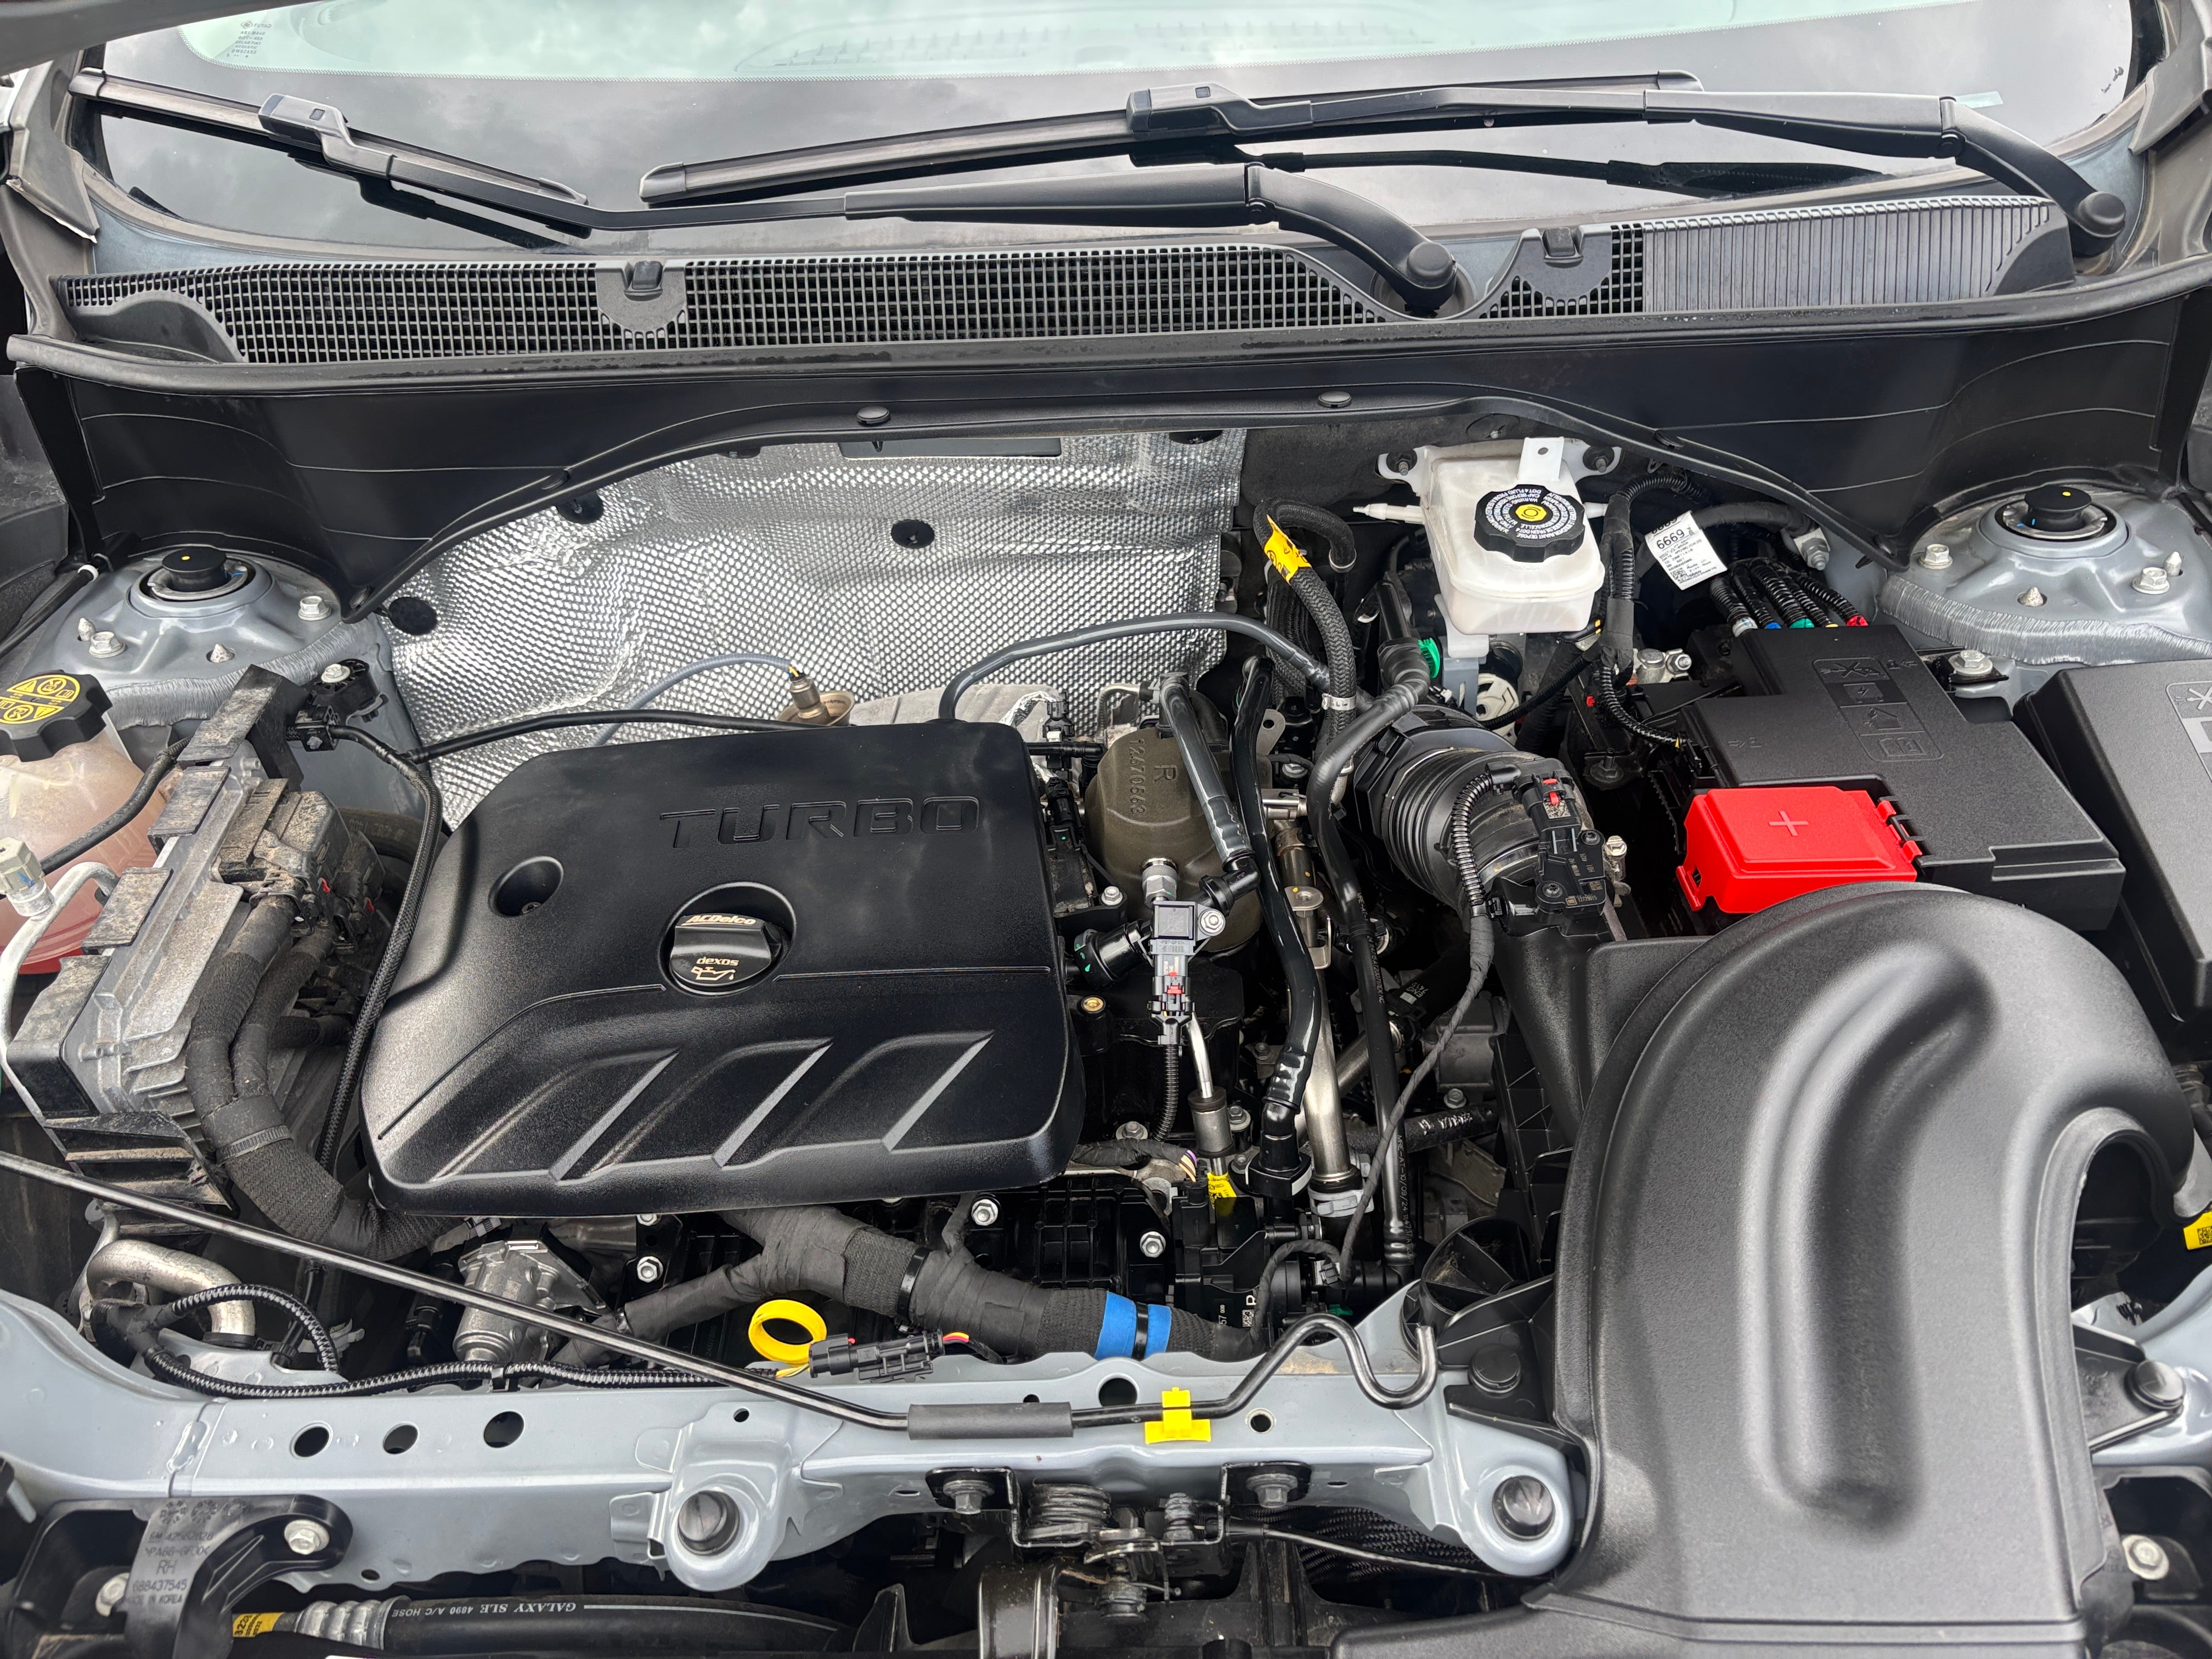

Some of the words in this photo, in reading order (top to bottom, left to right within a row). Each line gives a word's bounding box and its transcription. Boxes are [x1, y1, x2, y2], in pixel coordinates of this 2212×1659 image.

[1499, 520, 1514, 529] ONLY
[1657, 529, 1685, 549] 6669
[1154, 764, 1177, 783] R
[660, 796, 980, 848] TURBO
[689, 914, 757, 926] ACDelco
[697, 956, 740, 967] dexos
[156, 1560, 178, 1575] RH
[391, 1607, 422, 1618] HOSE
[425, 1606, 445, 1616] A/C
[449, 1606, 474, 1615] 4890
[480, 1604, 509, 1613] SLE
[514, 1602, 577, 1613] GALAXY
